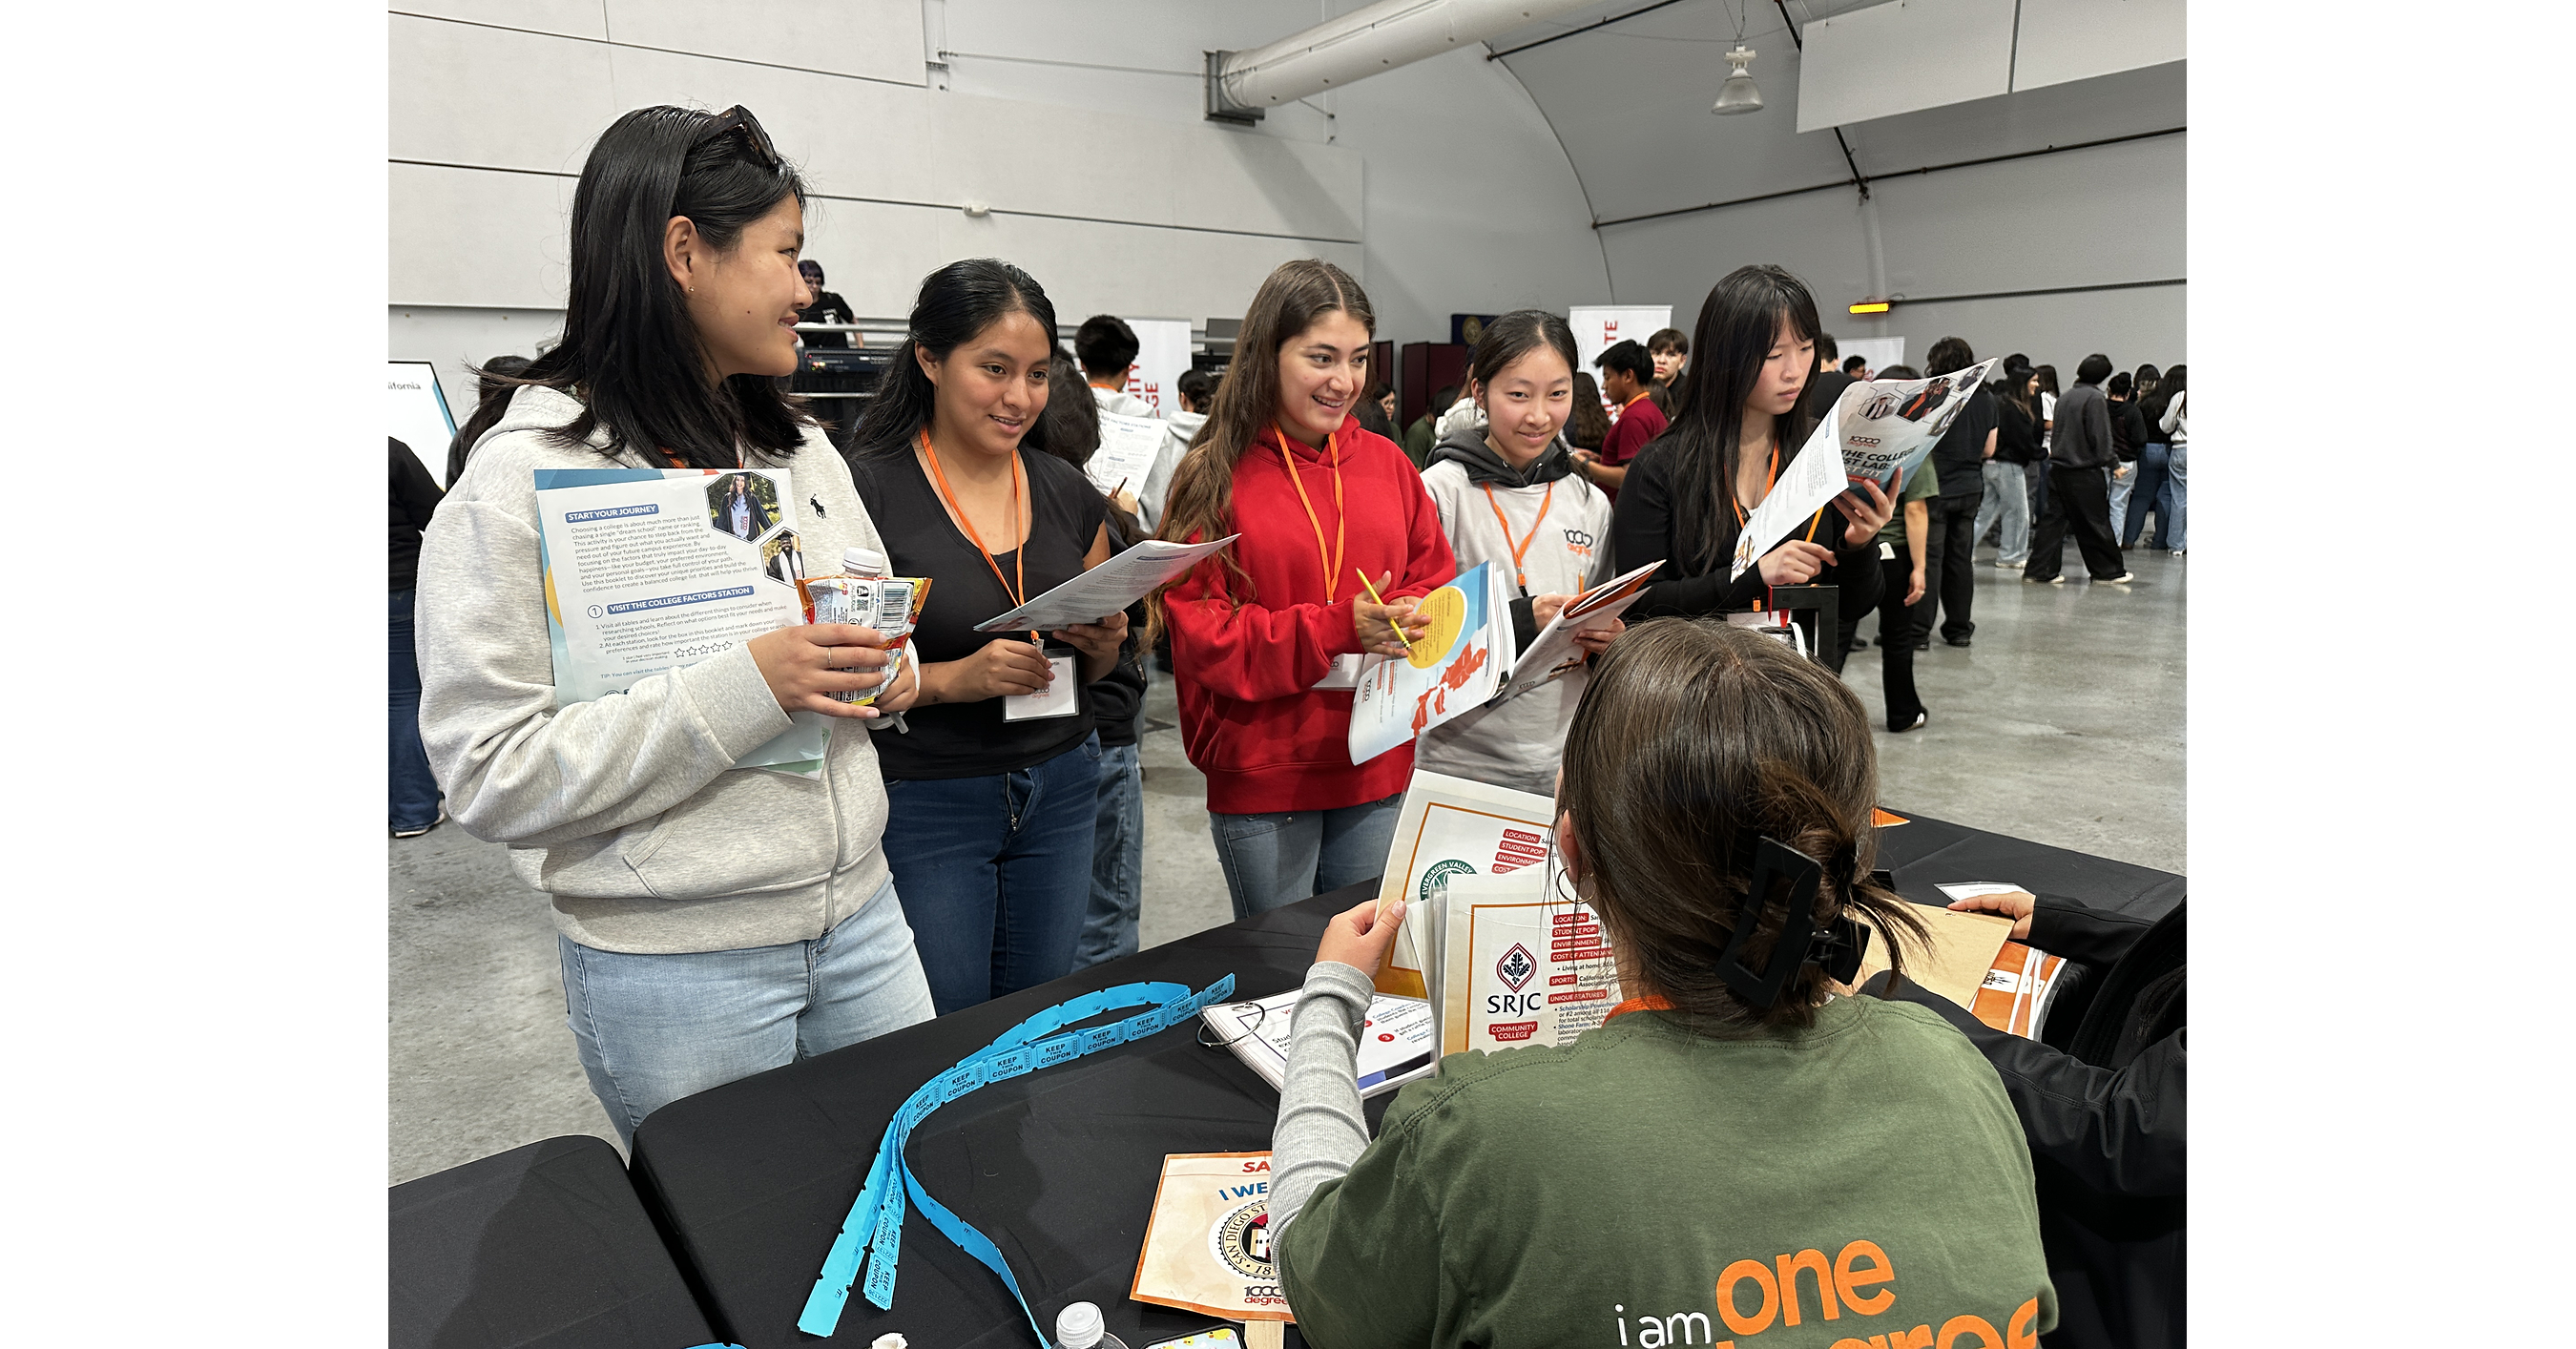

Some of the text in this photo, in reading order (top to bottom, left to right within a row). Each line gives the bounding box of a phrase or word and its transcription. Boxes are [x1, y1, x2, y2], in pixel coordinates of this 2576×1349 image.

[1841, 445, 1919, 462] THE COLLEGE
[1861, 460, 1890, 469] LAB:
[1861, 468, 1883, 478] FIT
[568, 505, 655, 521] START YOUR JOURNEY
[570, 526, 598, 535] Choosing
[602, 523, 623, 531] college
[571, 532, 594, 541] chasing
[679, 521, 700, 529] ranking.
[609, 603, 632, 612] VISIT
[631, 601, 647, 610] THE
[647, 596, 682, 608] COLLEGE
[682, 591, 717, 603] FACTORS
[717, 587, 750, 598] STATION
[1505, 831, 1537, 842] LOCATION:
[1501, 842, 1545, 857] STUDENT POP:
[1422, 861, 1473, 895] EVERGREEN VALLEY
[1487, 992, 1541, 1018] SRJC
[1136, 1017, 1154, 1027] KEEP
[1491, 1024, 1536, 1033] COMMUNITY
[1092, 1030, 1111, 1040] KEEP
[1132, 1024, 1159, 1036] COUPON
[1498, 1031, 1528, 1040] COLLEGE
[1046, 1044, 1066, 1052] KEEP
[1088, 1037, 1116, 1050] COUPON
[998, 1056, 1017, 1067] KEEP
[1041, 1050, 1071, 1064] COUPON
[992, 1065, 1024, 1078] COUPON
[952, 1072, 970, 1086] KEEP
[947, 1079, 976, 1097] COUPON
[916, 1094, 929, 1109] KEEP
[913, 1102, 934, 1122] COUPON
[1242, 1161, 1270, 1173] SA
[1218, 1182, 1268, 1201] I WE
[880, 1216, 888, 1246] COUPON
[1225, 1203, 1266, 1265] SAN DIEGO ST
[871, 1258, 881, 1290] COUPON
[1255, 1265, 1271, 1276] 18
[883, 1270, 891, 1291] KEEP
[1244, 1285, 1282, 1297] 1000
[1715, 1239, 1897, 1337] one
[1614, 1304, 1628, 1346] i
[1638, 1310, 1711, 1349] am
